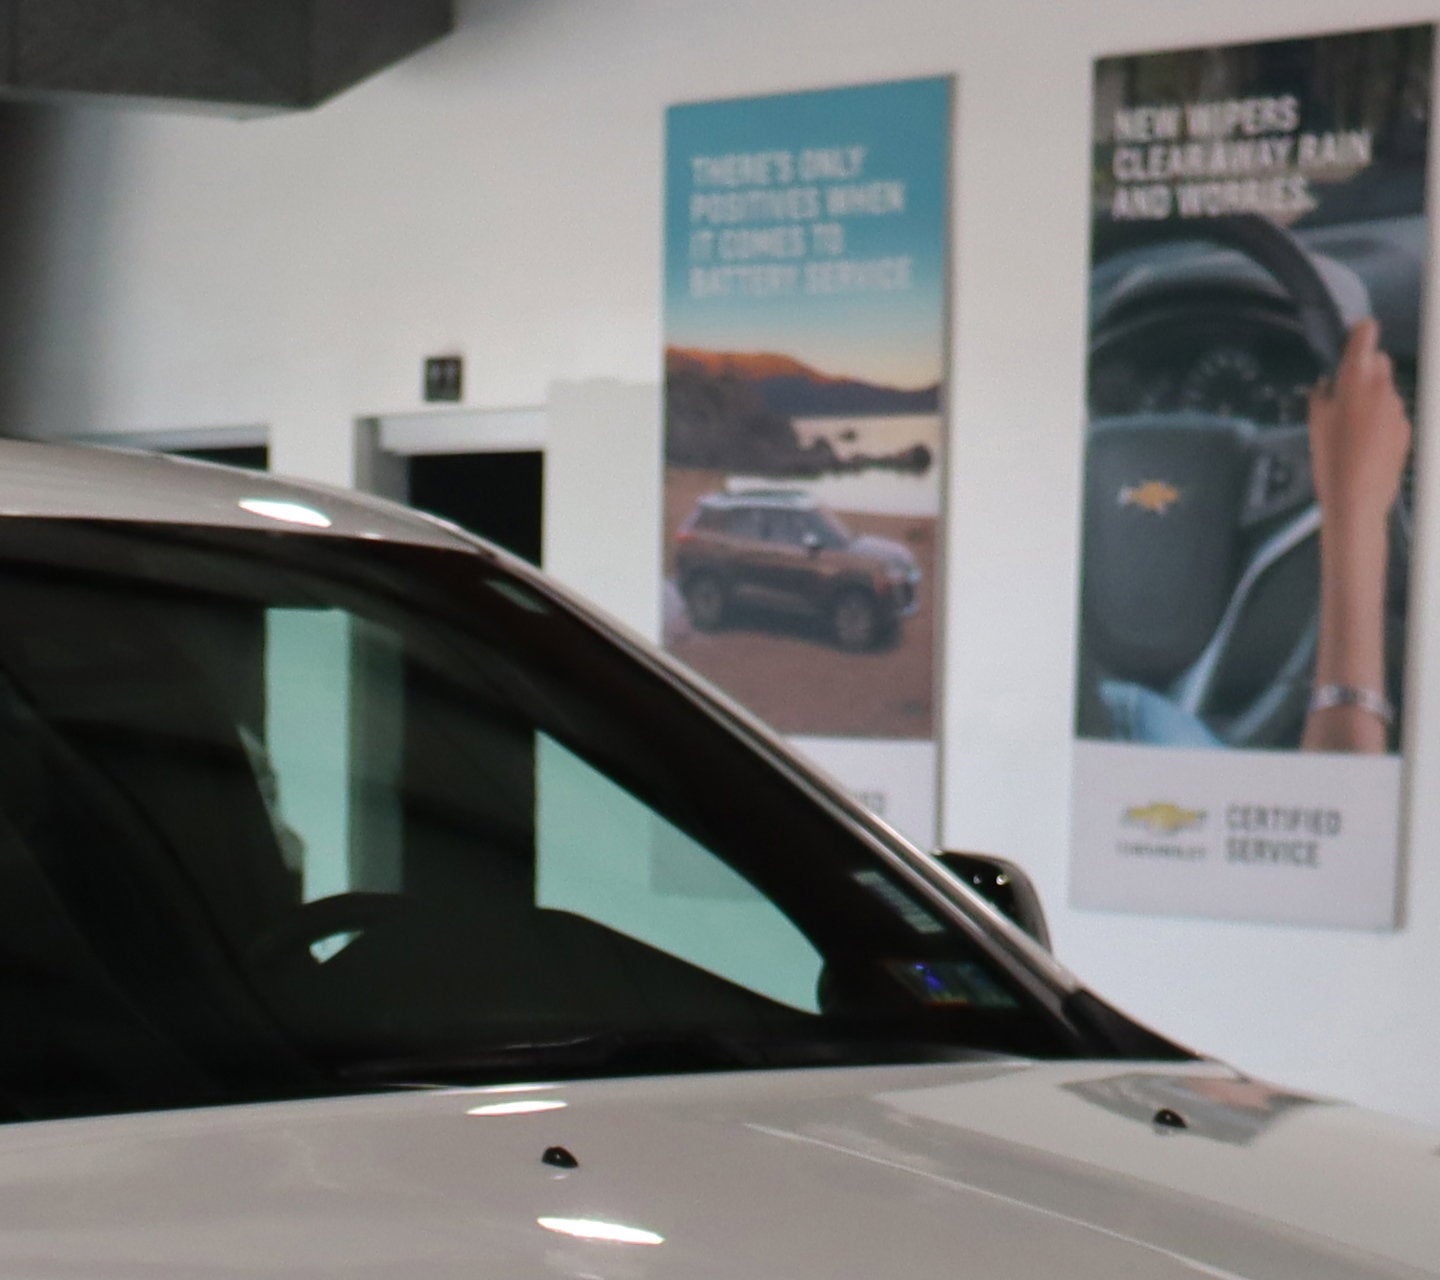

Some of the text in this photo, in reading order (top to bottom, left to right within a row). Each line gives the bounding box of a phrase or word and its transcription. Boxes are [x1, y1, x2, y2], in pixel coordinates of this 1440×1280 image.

[1113, 95, 1298, 140] NEW WIPERS
[799, 146, 868, 182] ONLY
[1112, 130, 1373, 180] CLEAR AWAY RAIN
[689, 181, 904, 224] POSITIVES WHEN
[1111, 184, 1172, 221] AND
[689, 222, 845, 261] IT COMES TO
[688, 256, 913, 299] BATTERY SERVICE
[1224, 804, 1342, 837] CERTIFIED
[1224, 837, 1320, 869] SERVICE
